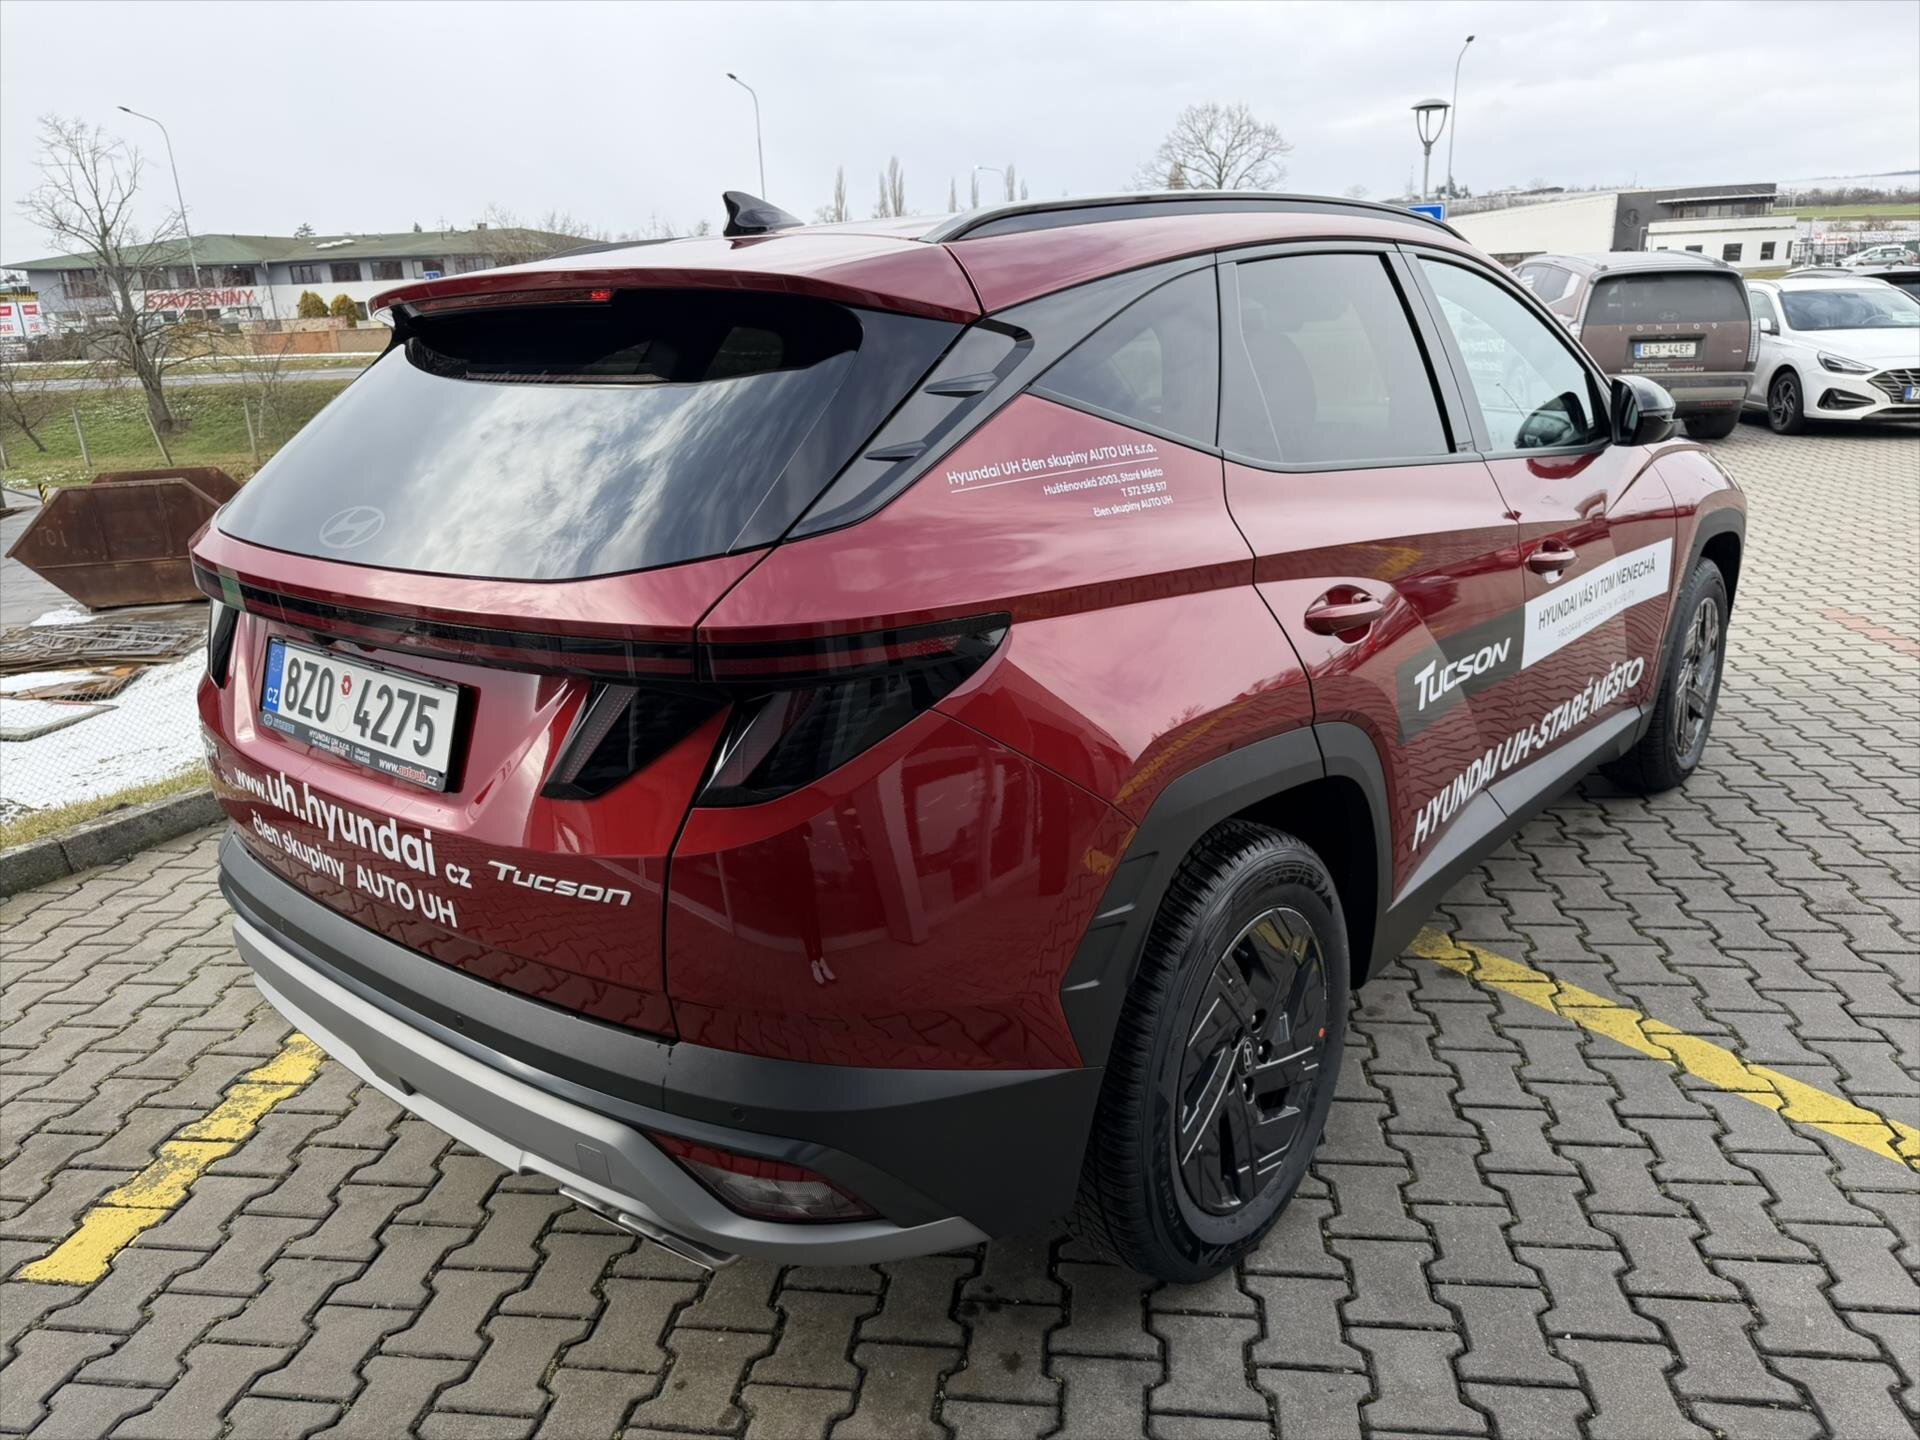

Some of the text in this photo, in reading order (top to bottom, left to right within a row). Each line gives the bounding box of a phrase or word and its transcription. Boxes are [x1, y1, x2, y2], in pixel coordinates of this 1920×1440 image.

[1642, 343, 1692, 355] EL3 44EF
[945, 442, 1157, 486] Hyundai UH člen skupiny AUTO UH s.r.o.
[1043, 467, 1164, 496] Huštěnovská 2003, Staré Město
[1121, 487, 1128, 497] T
[1127, 485, 1142, 497] 572
[1156, 480, 1168, 493] 517
[1093, 495, 1174, 518] člen skupiny AUTO UH
[1538, 595, 1578, 630] HYUNDAI
[1577, 584, 1593, 608] VÁS
[1593, 584, 1602, 601] V
[1599, 573, 1617, 599] TOM
[1615, 553, 1656, 586] NENECHÁ
[266, 686, 279, 706] CZ
[284, 656, 440, 757] 8Z0 4275
[1411, 656, 1645, 851] HYUNDAI UH-STARÉ MĚSTO
[378, 758, 438, 787] www.autouh.cz
[251, 809, 459, 930] člen skupiny AUTO UH
